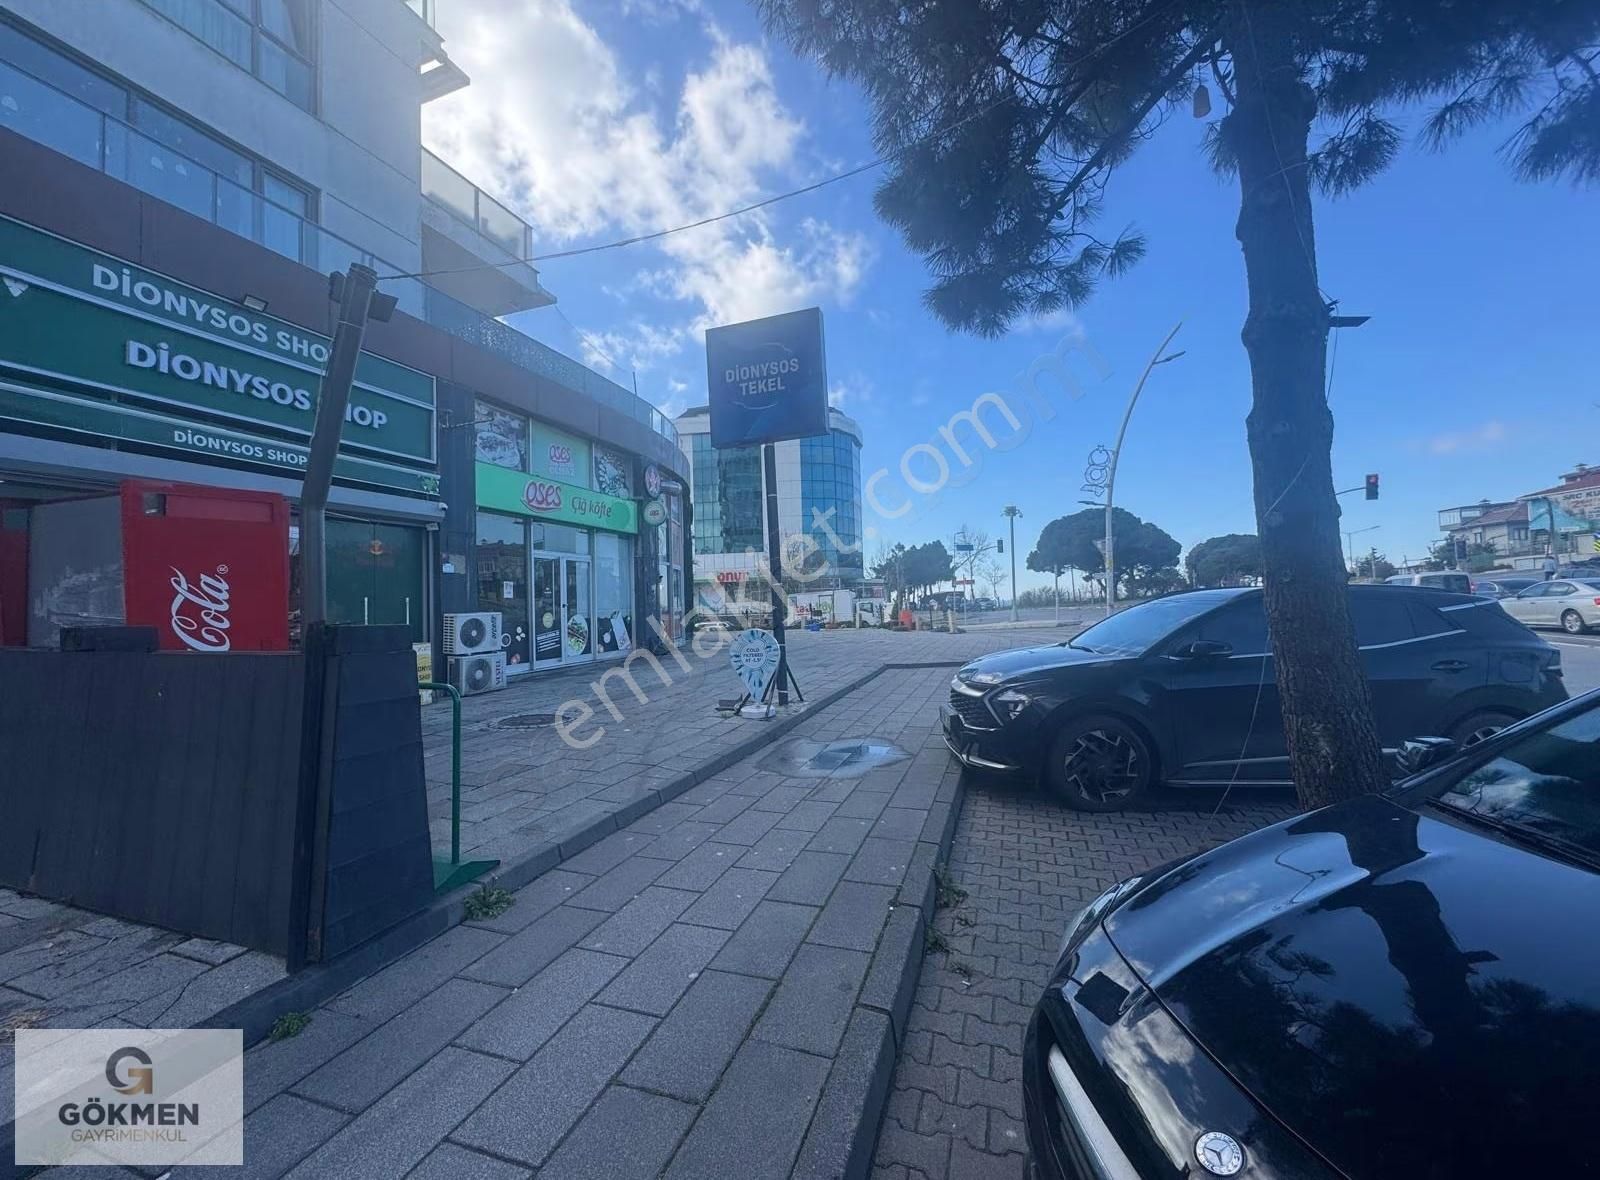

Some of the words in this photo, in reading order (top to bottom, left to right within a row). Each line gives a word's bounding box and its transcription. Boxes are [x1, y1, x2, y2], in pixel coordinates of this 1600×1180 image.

[92, 263, 269, 343] DİONYSOS
[276, 330, 331, 363] SHO
[126, 340, 311, 411] DİONYSOS
[725, 357, 799, 384] DİONYSOS
[739, 377, 785, 396] TEKEL
[267, 448, 308, 465] SHOP
[525, 481, 562, 507] oses
[588, 501, 612, 519] köfte
